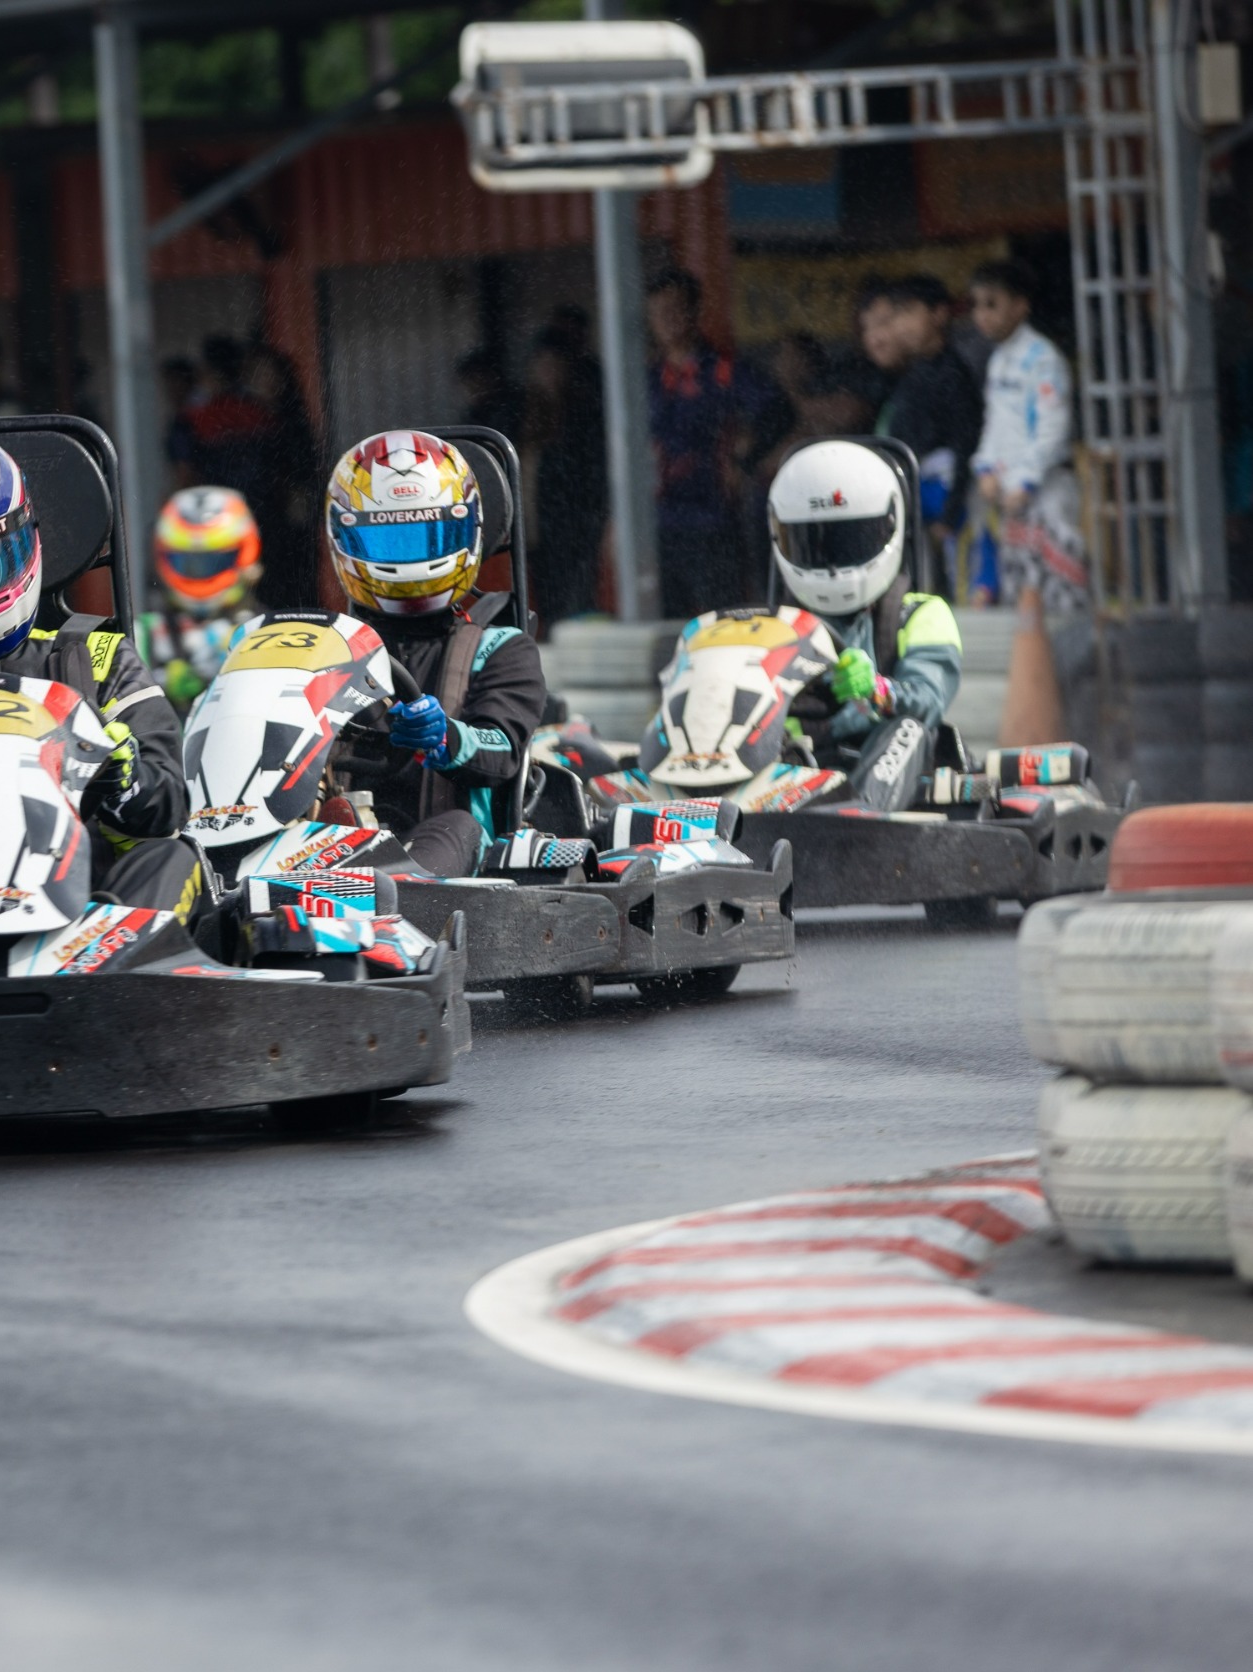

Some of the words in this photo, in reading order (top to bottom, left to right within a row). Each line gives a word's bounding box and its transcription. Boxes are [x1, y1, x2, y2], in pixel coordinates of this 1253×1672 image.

[393, 486, 420, 495] BELL
[369, 508, 442, 524] LOVEKART
[249, 631, 318, 650] 73
